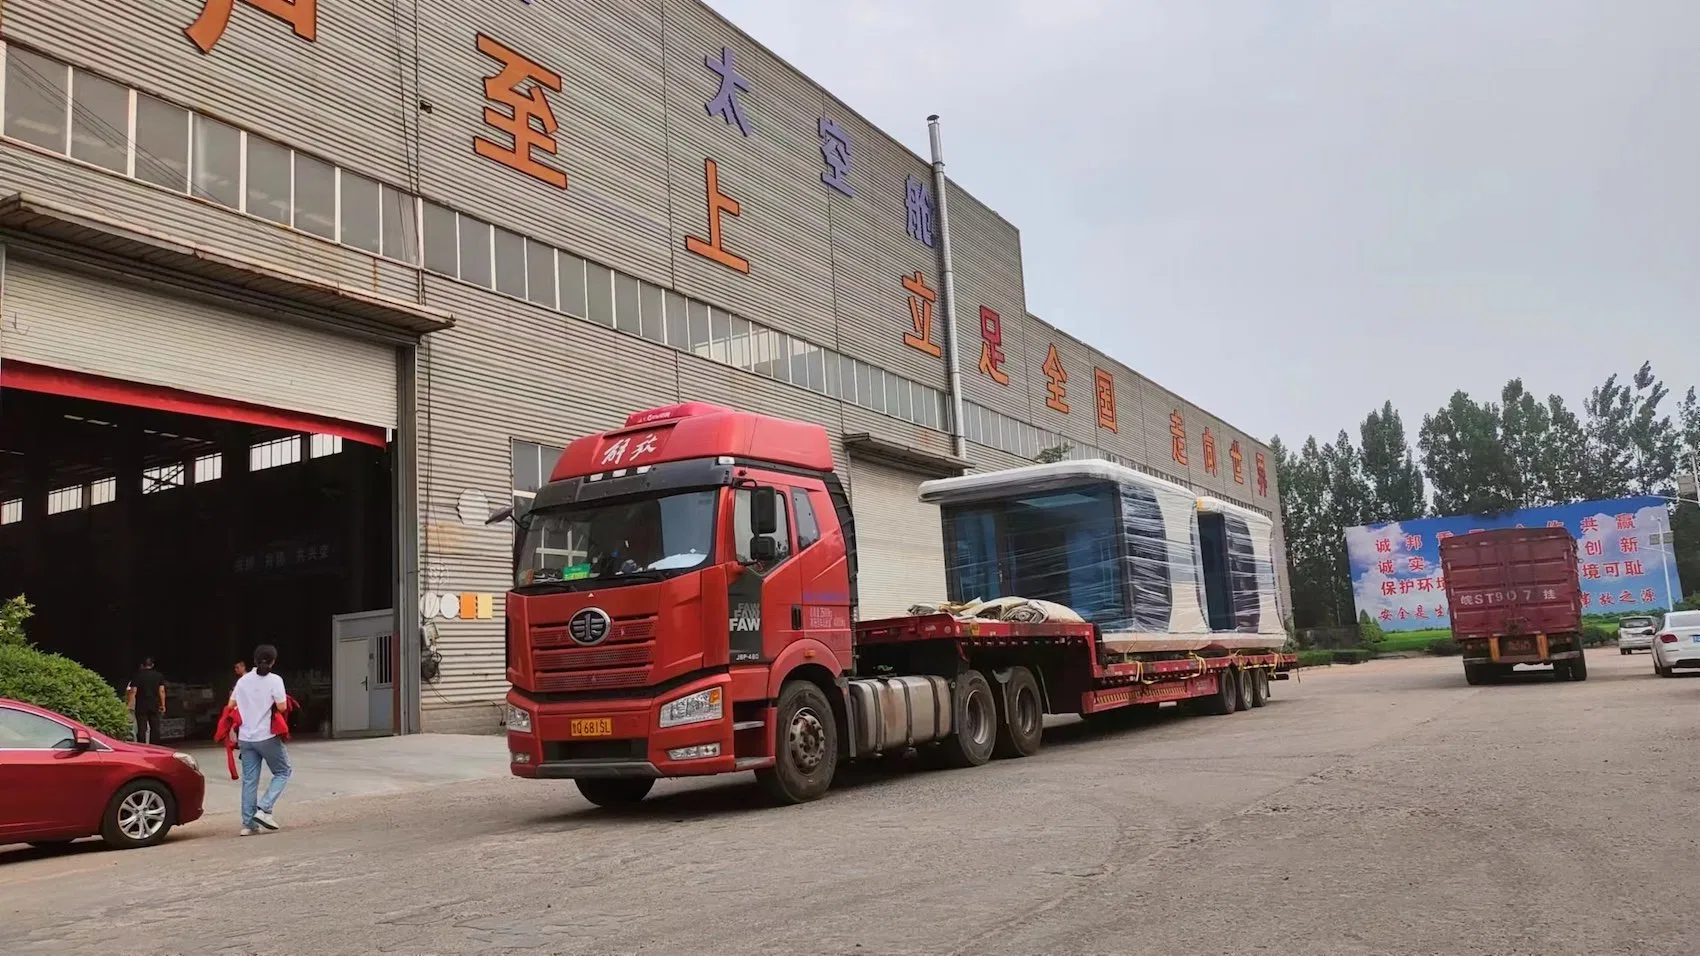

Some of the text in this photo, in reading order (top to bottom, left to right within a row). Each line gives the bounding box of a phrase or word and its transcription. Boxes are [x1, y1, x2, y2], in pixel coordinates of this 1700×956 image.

[704, 46, 937, 249] 太空舱
[729, 618, 761, 632] FAW
